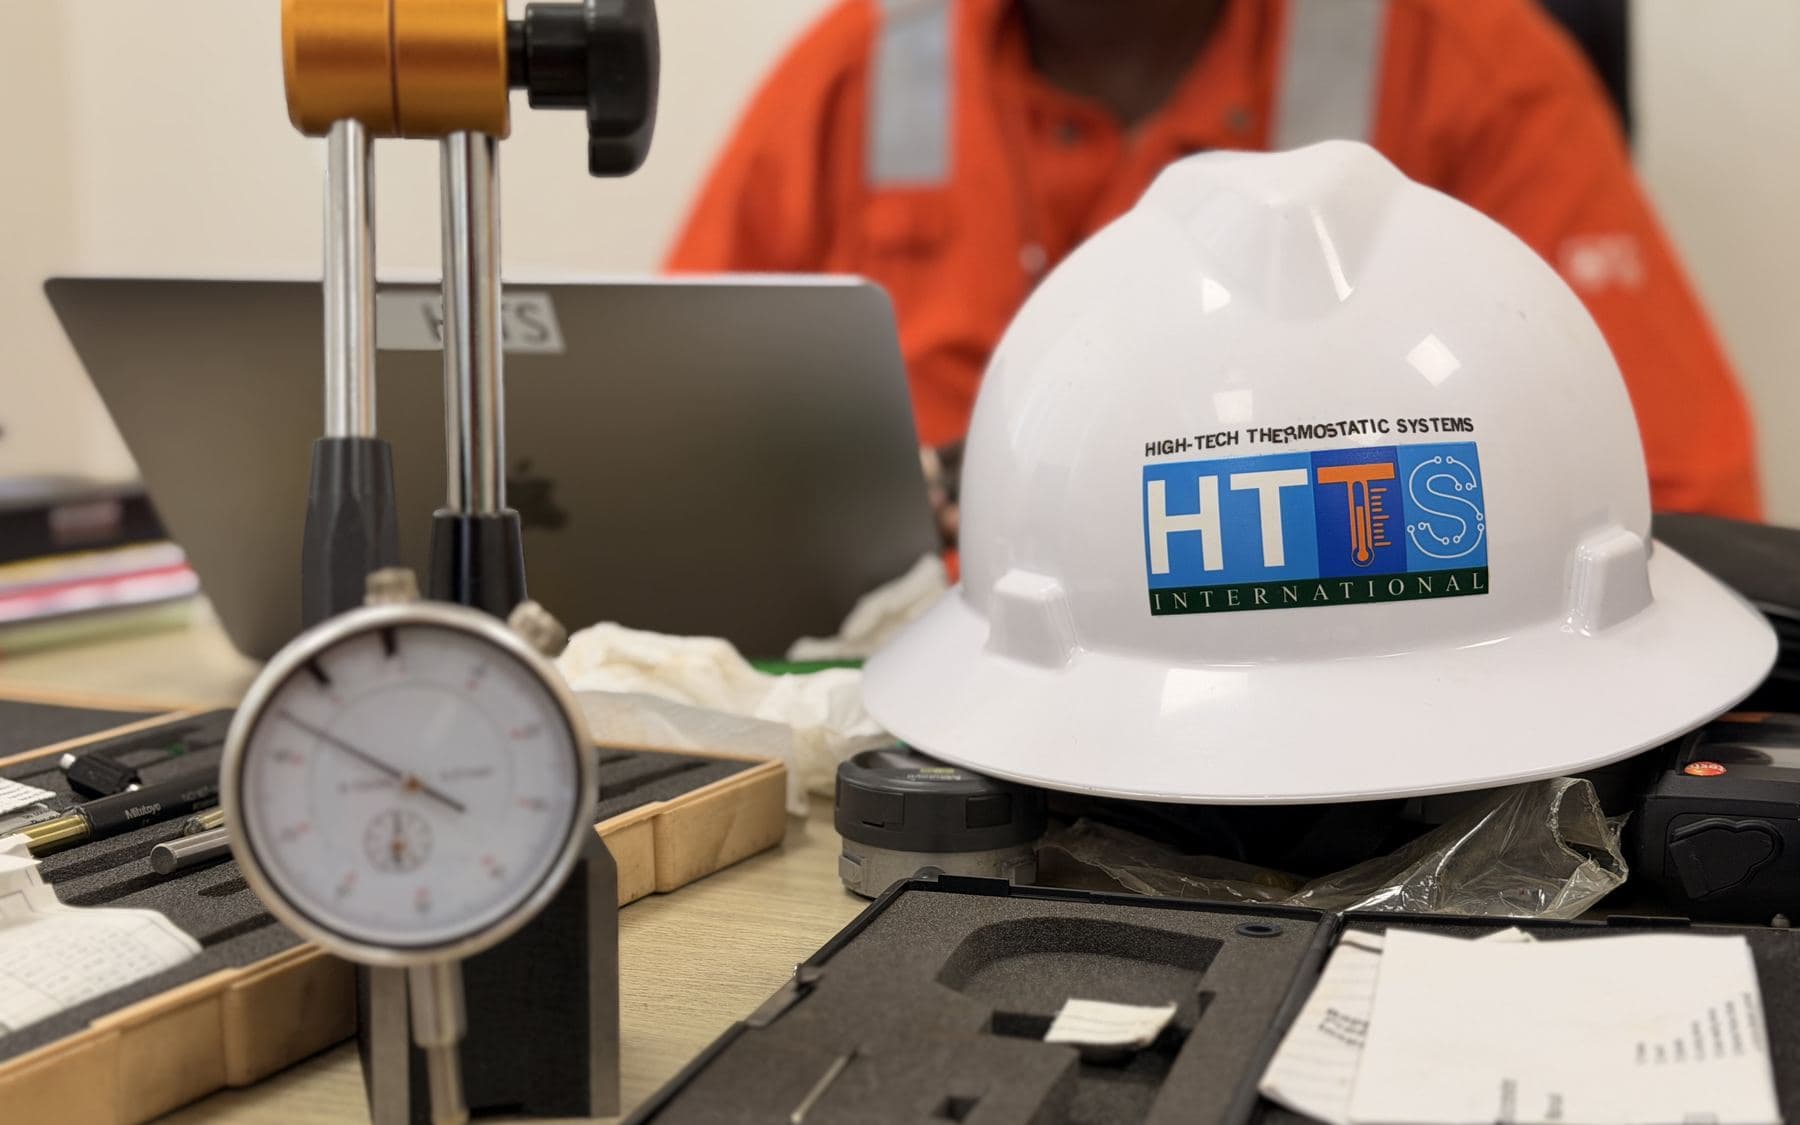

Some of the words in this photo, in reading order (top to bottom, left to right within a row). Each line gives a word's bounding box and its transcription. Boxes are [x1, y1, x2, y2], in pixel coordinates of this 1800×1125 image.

[1144, 430, 1240, 457] HIGH-TECH
[1246, 418, 1391, 445] THERMOSTATIC
[1396, 416, 1475, 433] SYSTEMS
[1148, 456, 1485, 574] HTTS
[1154, 572, 1484, 610] INTERNATIONAL
[125, 803, 161, 819] Mitutoyo
